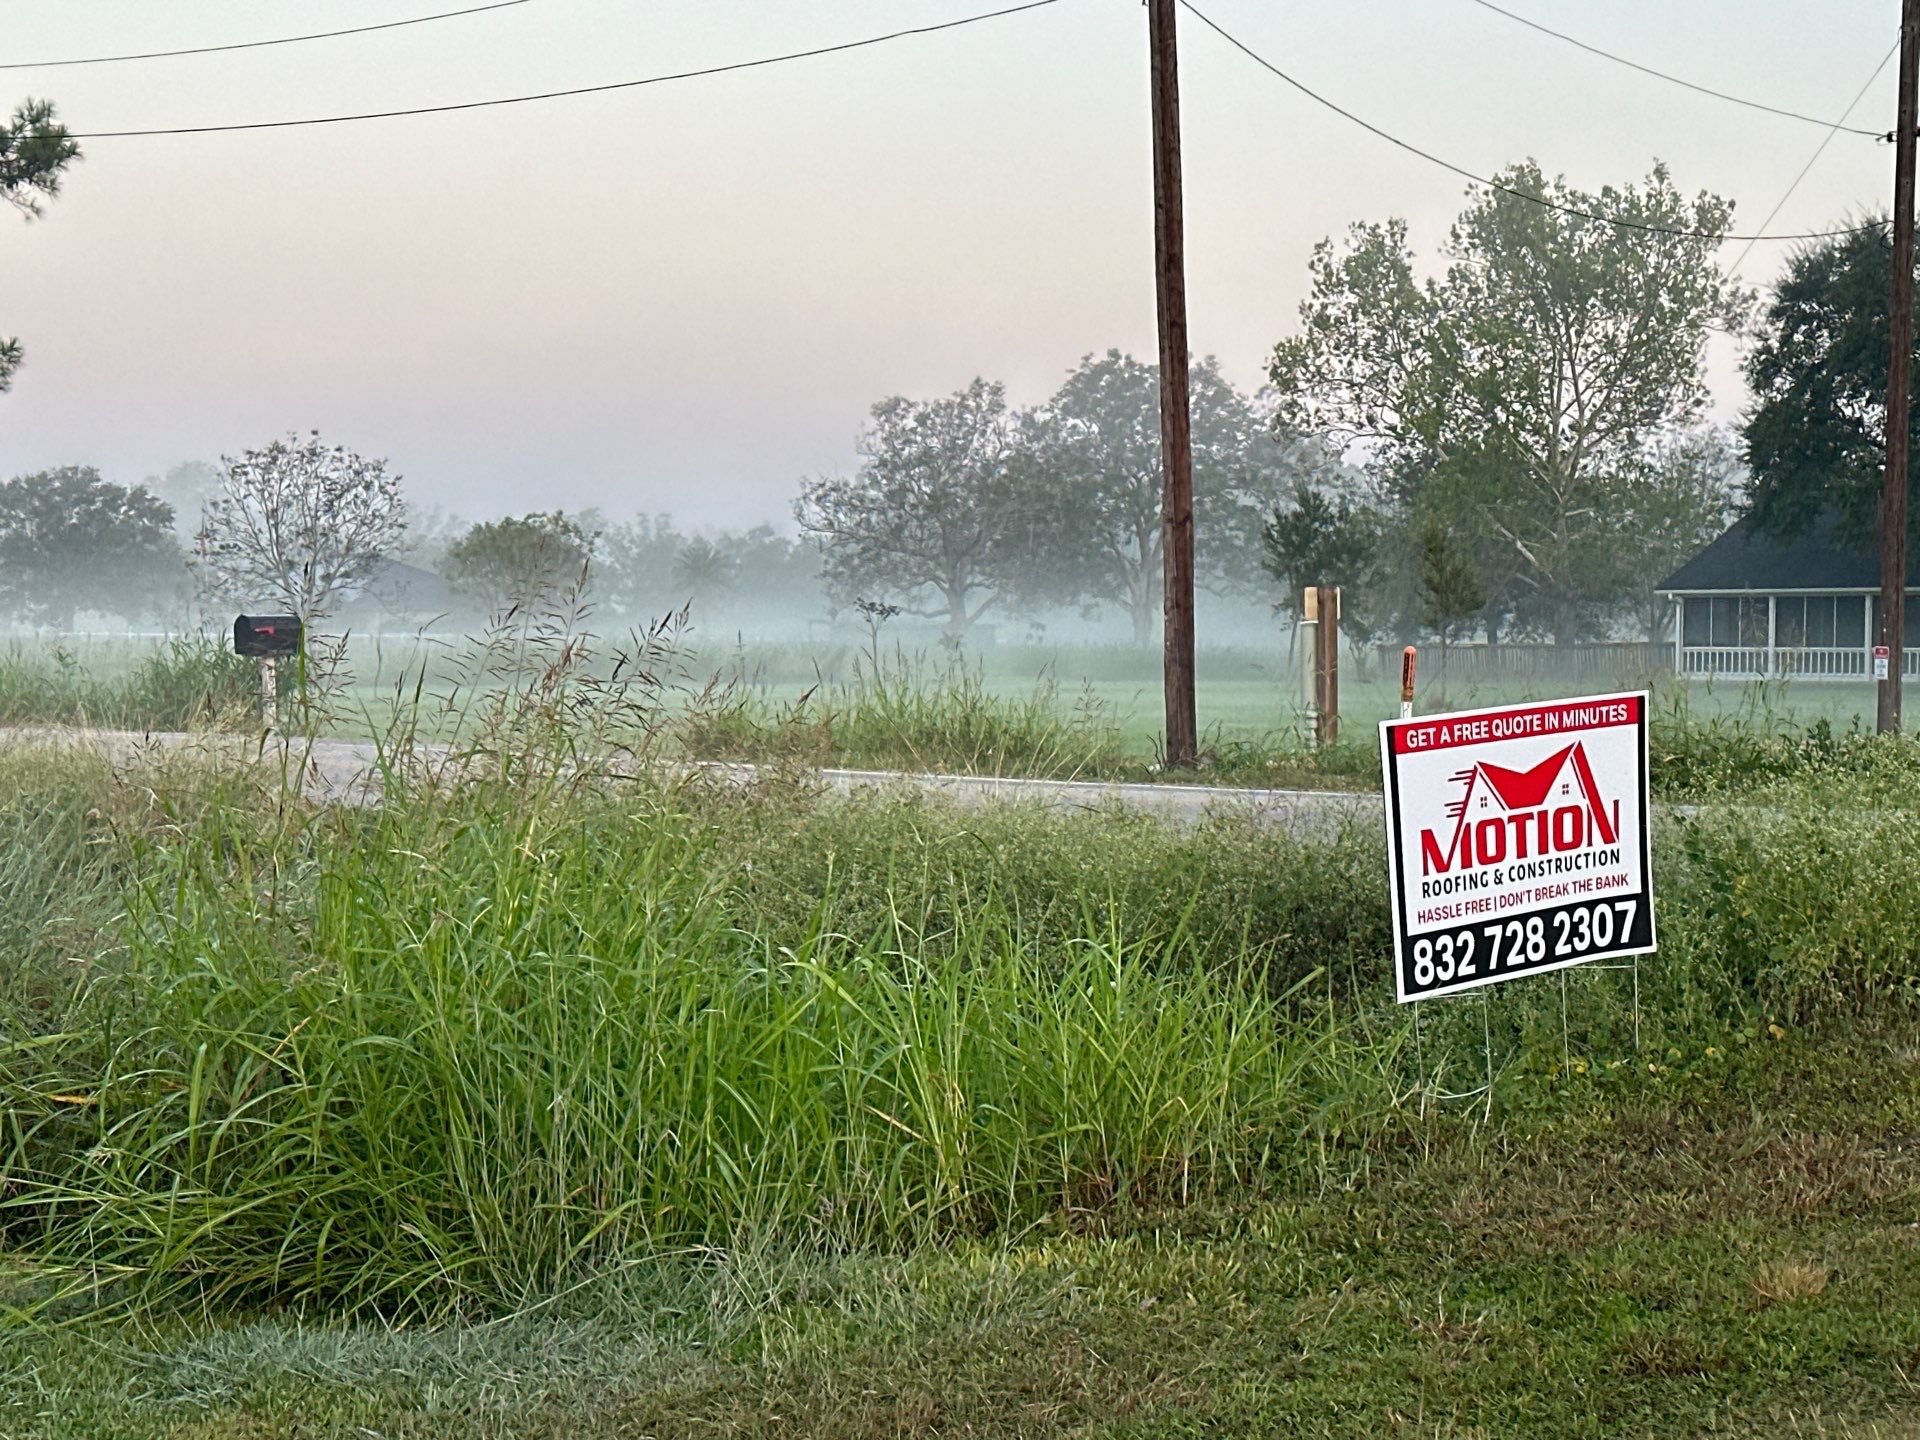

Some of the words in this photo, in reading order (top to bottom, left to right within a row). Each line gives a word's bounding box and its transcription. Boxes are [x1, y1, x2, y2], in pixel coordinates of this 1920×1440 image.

[1406, 727, 1437, 749] GET
[1439, 725, 1452, 744] A
[1453, 720, 1490, 742] FREE
[1491, 713, 1541, 739] QUOTE
[1544, 710, 1559, 729] IN
[1562, 704, 1628, 728] MINUTES
[1420, 787, 1620, 877] MOTION
[1417, 902, 1463, 925] HASSLE
[1464, 897, 1492, 917] FREE
[1499, 889, 1532, 909] DON'T
[1535, 882, 1570, 902] BREAK
[1572, 877, 1594, 894] THE
[1596, 873, 1629, 890] BANK
[1422, 871, 1489, 899] ROOFING
[1493, 868, 1504, 886] &
[1508, 848, 1621, 883] CONSTRUCTION
[1413, 930, 1477, 986] 832
[1484, 916, 1546, 970] 728
[1553, 900, 1637, 956] 2307
